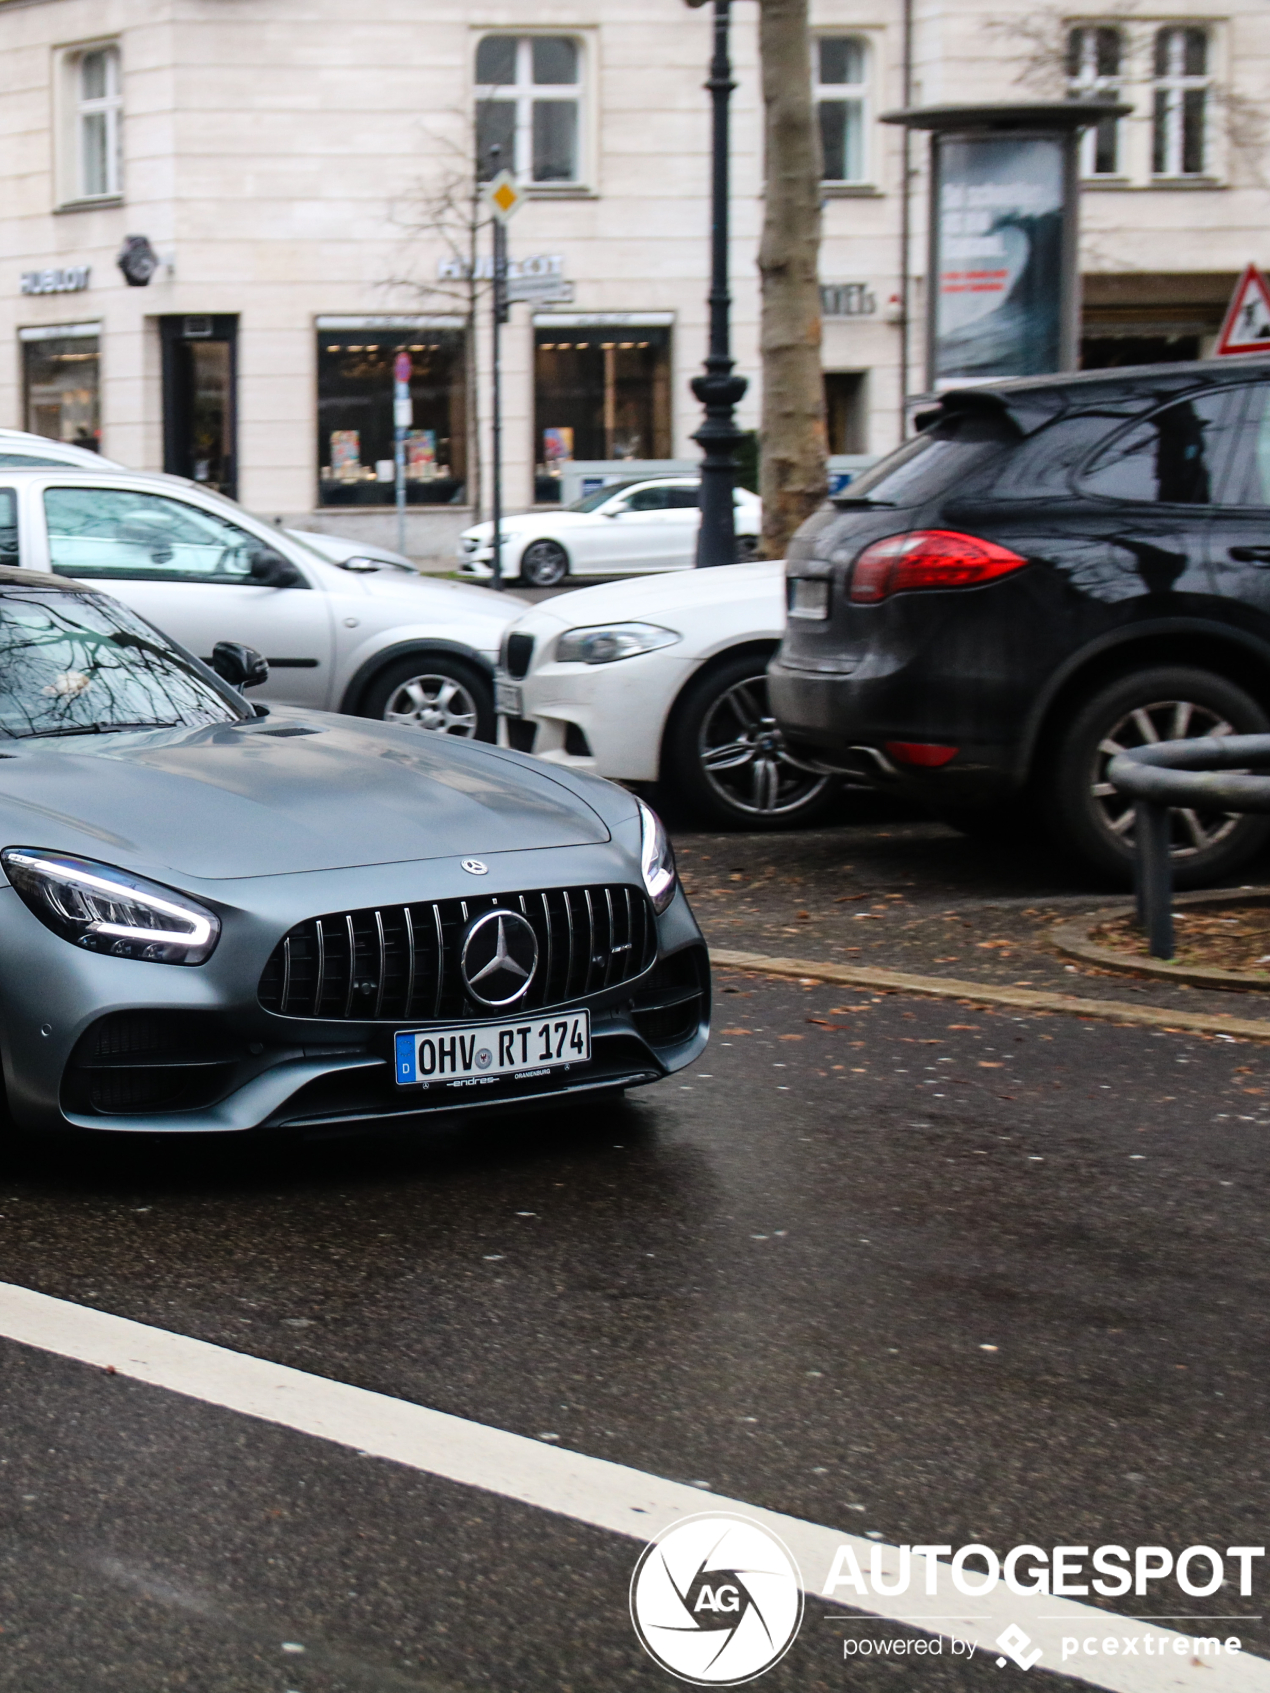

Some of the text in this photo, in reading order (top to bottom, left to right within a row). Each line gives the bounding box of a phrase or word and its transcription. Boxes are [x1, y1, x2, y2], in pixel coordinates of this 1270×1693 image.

[438, 254, 564, 279] HULOT
[418, 1018, 584, 1075] OHV RT 174
[402, 1063, 410, 1074] D
[514, 1068, 551, 1079] ORANIENBURG
